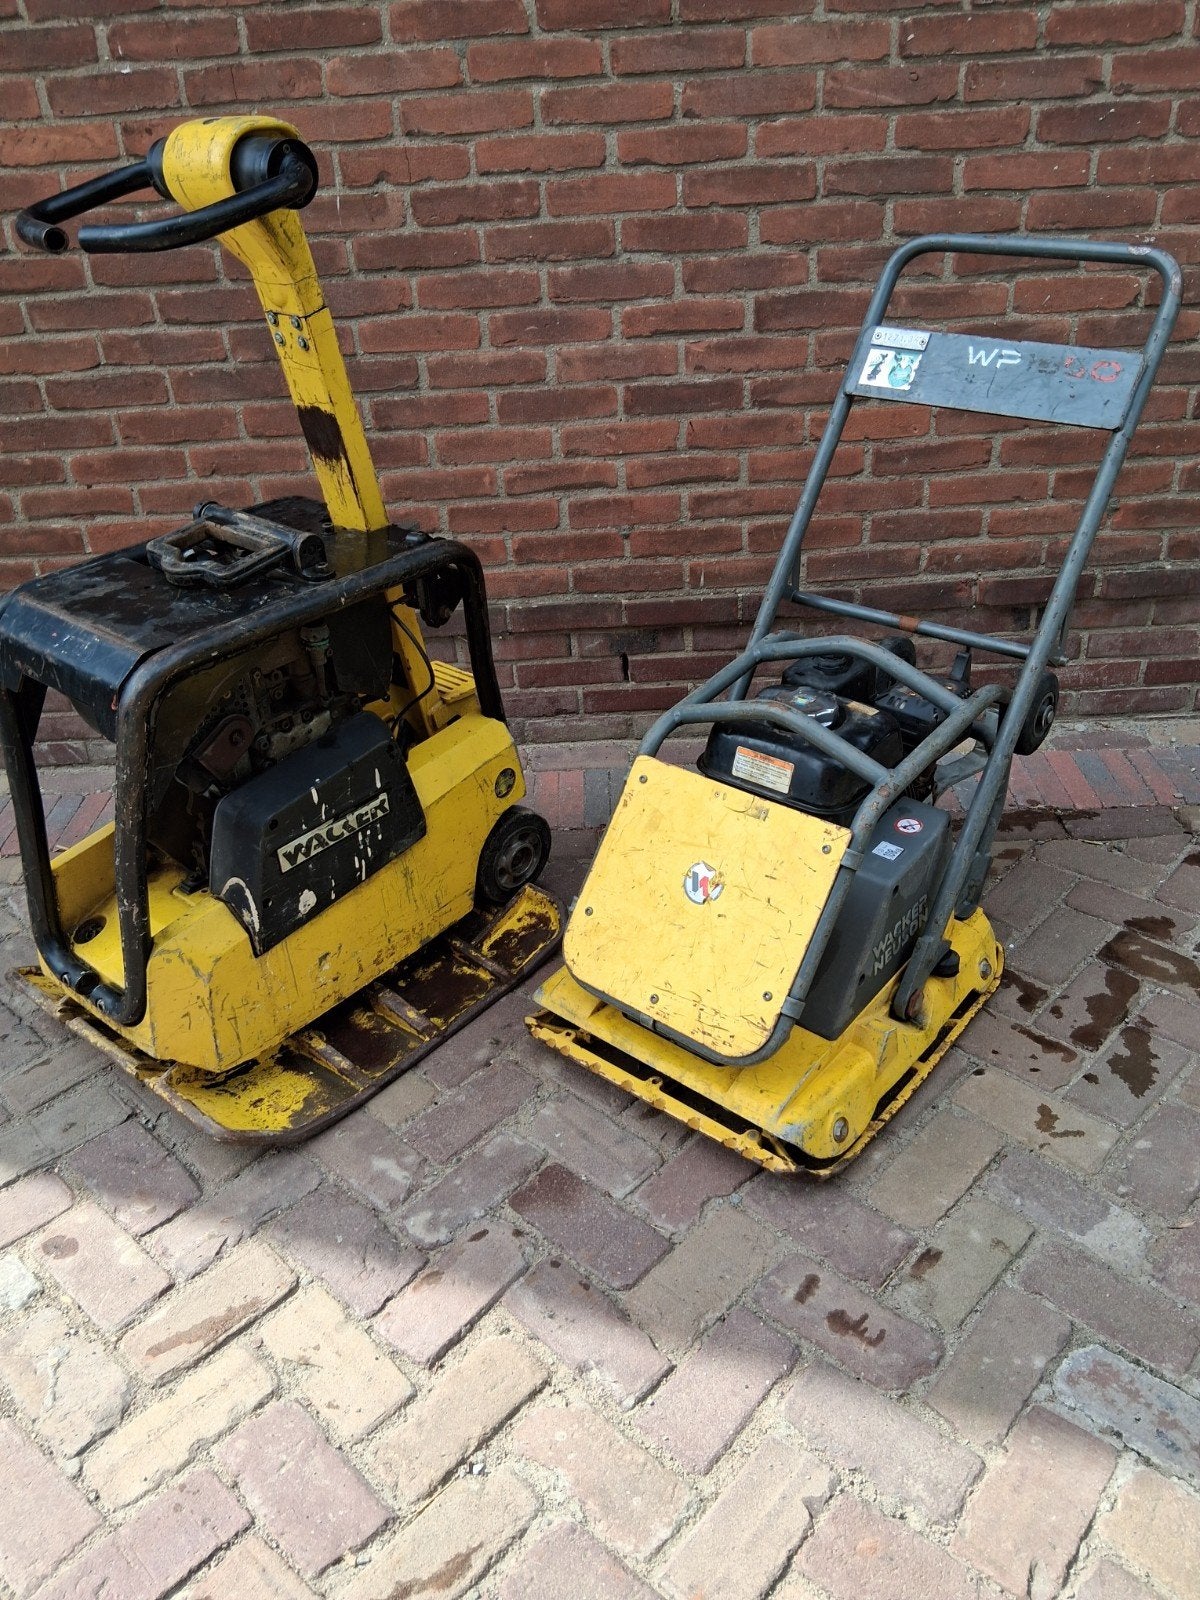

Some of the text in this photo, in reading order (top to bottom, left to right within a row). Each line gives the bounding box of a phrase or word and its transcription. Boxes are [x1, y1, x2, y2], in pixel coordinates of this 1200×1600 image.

[282, 799, 389, 866] WACKER
[872, 894, 928, 959] WACKER
[874, 906, 929, 976] NEUSON
